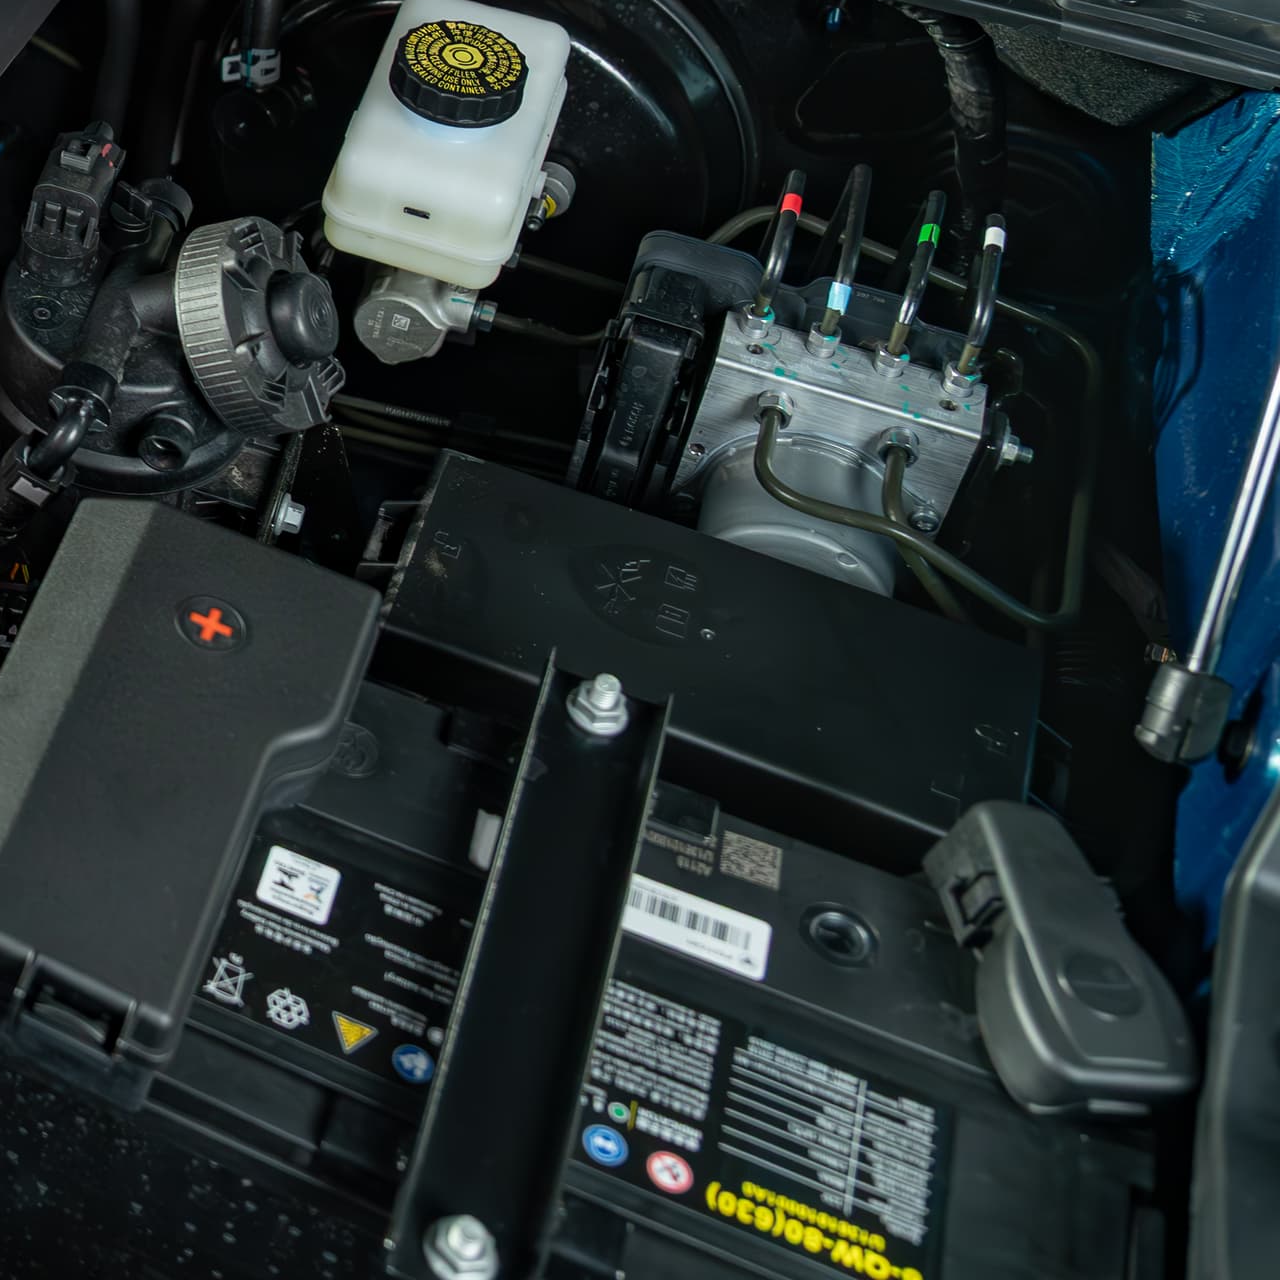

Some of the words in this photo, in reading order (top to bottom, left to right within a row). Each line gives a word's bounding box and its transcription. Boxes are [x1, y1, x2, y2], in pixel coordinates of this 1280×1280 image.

[410, 63, 438, 85] SEALED
[436, 80, 486, 94] CONTAINER
[416, 53, 444, 79] REMOVING
[441, 74, 458, 84] USE
[460, 78, 482, 86] ONLY
[429, 55, 450, 72] CLEAN
[449, 68, 477, 78] FILLER
